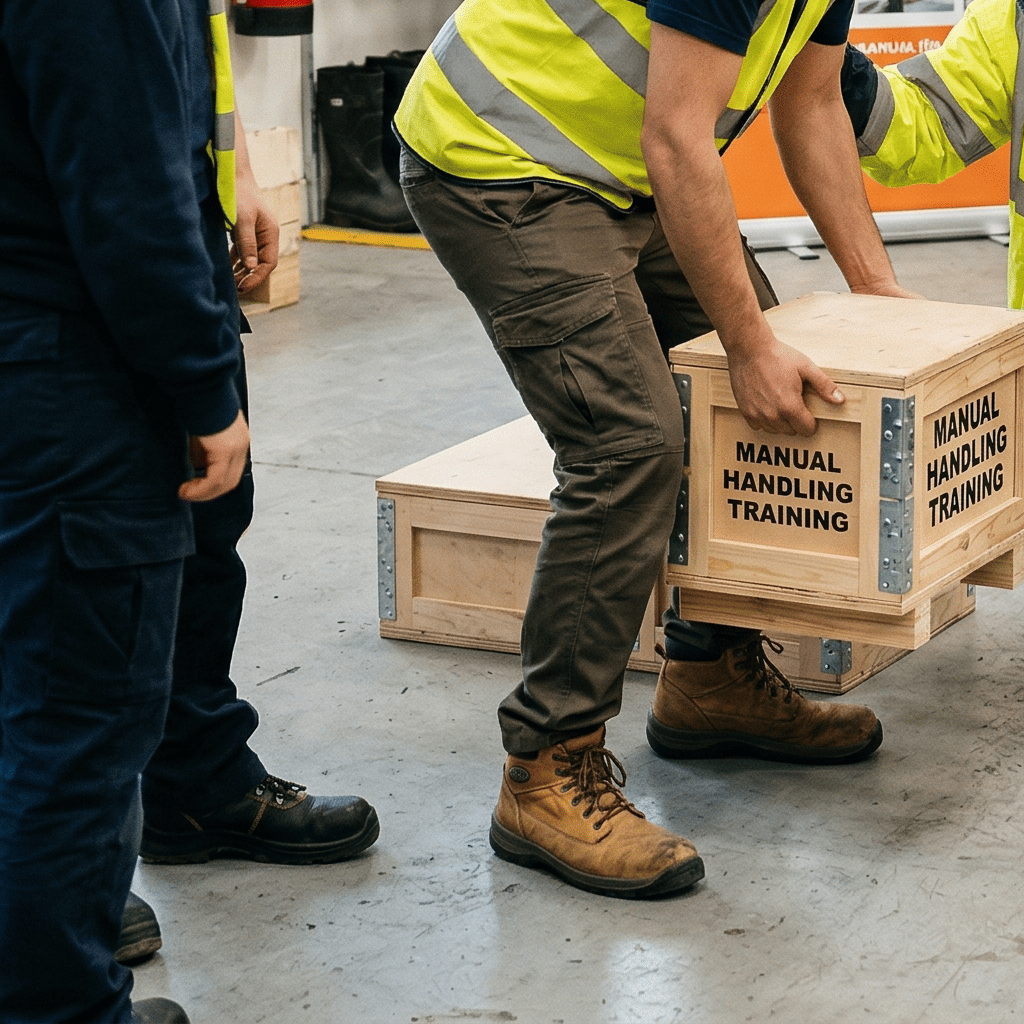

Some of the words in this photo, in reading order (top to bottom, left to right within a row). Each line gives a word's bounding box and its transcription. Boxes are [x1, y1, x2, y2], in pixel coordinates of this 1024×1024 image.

[935, 391, 1000, 449] MANUAL
[736, 441, 842, 474] MANUAL
[927, 424, 1007, 491] HANDLING
[723, 469, 853, 504] HANDLING
[929, 463, 1004, 528] TRAINING
[727, 498, 849, 532] TRAINING
